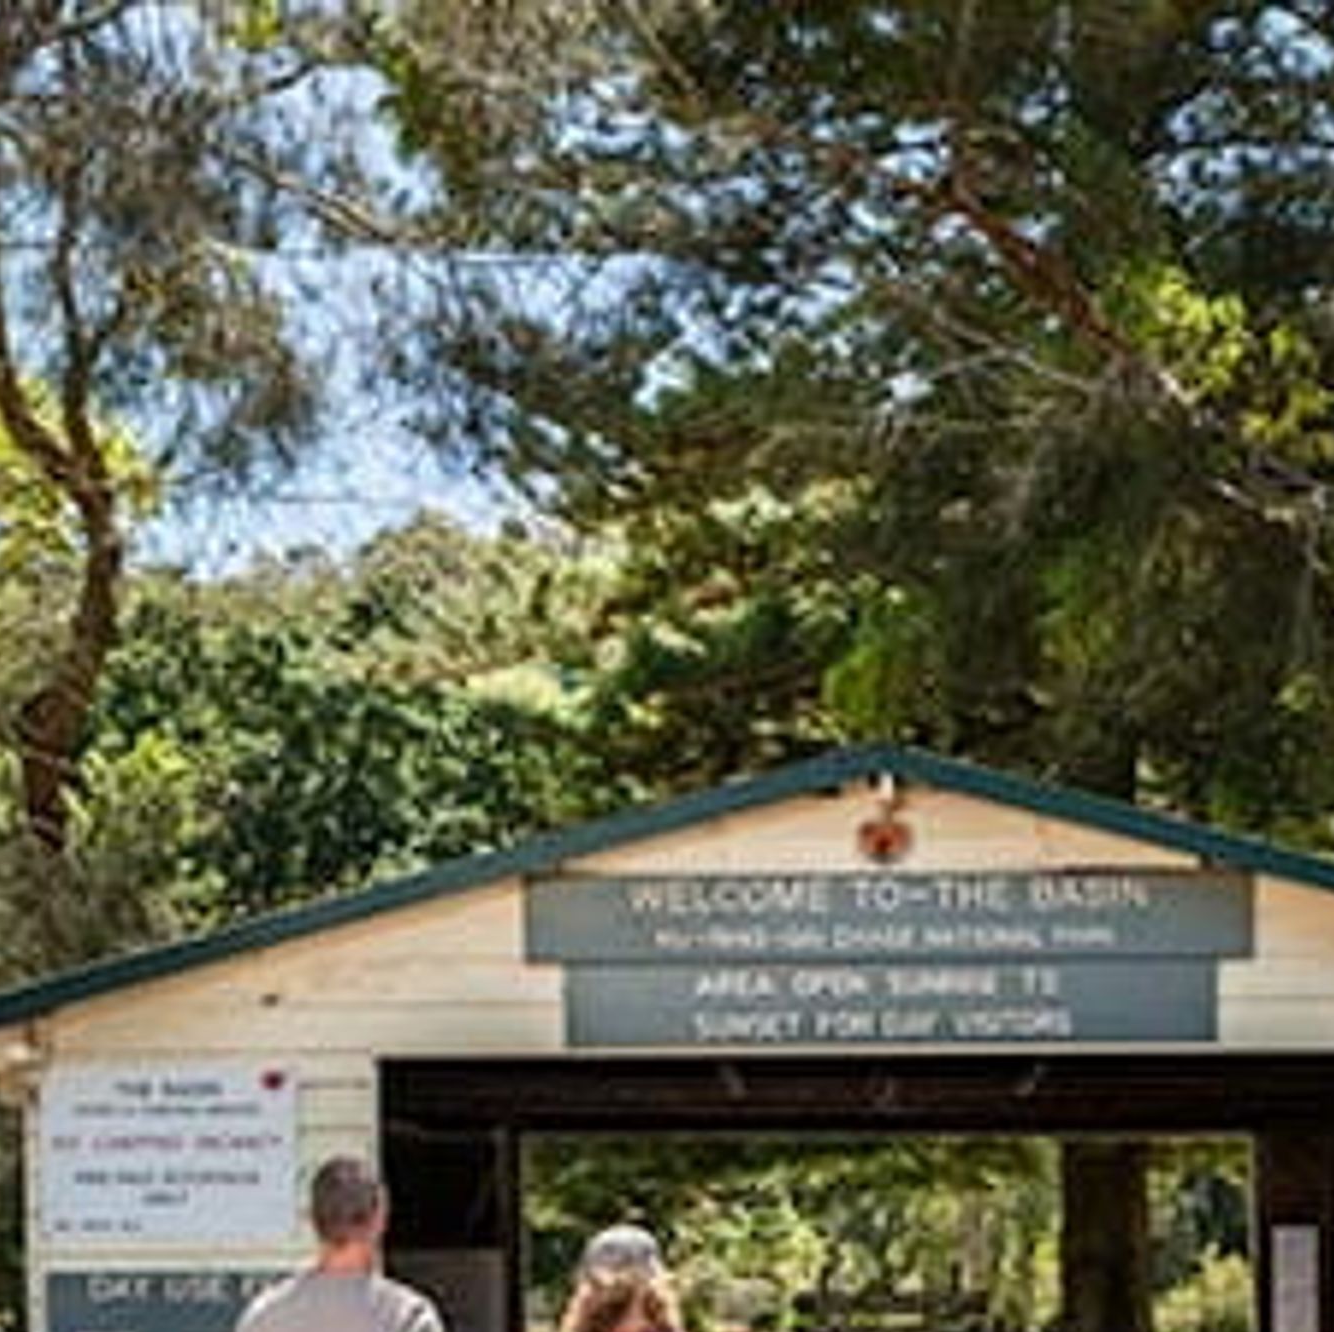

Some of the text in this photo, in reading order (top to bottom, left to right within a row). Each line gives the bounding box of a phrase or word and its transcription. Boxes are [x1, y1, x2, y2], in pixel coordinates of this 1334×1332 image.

[628, 878, 829, 914] WELCOME
[1030, 874, 1149, 909] BASIN
[695, 966, 774, 997] AREA
[791, 966, 867, 997] OPEN
[694, 1010, 801, 1039] SUNSET
[953, 1008, 1072, 1037] VISITORS
